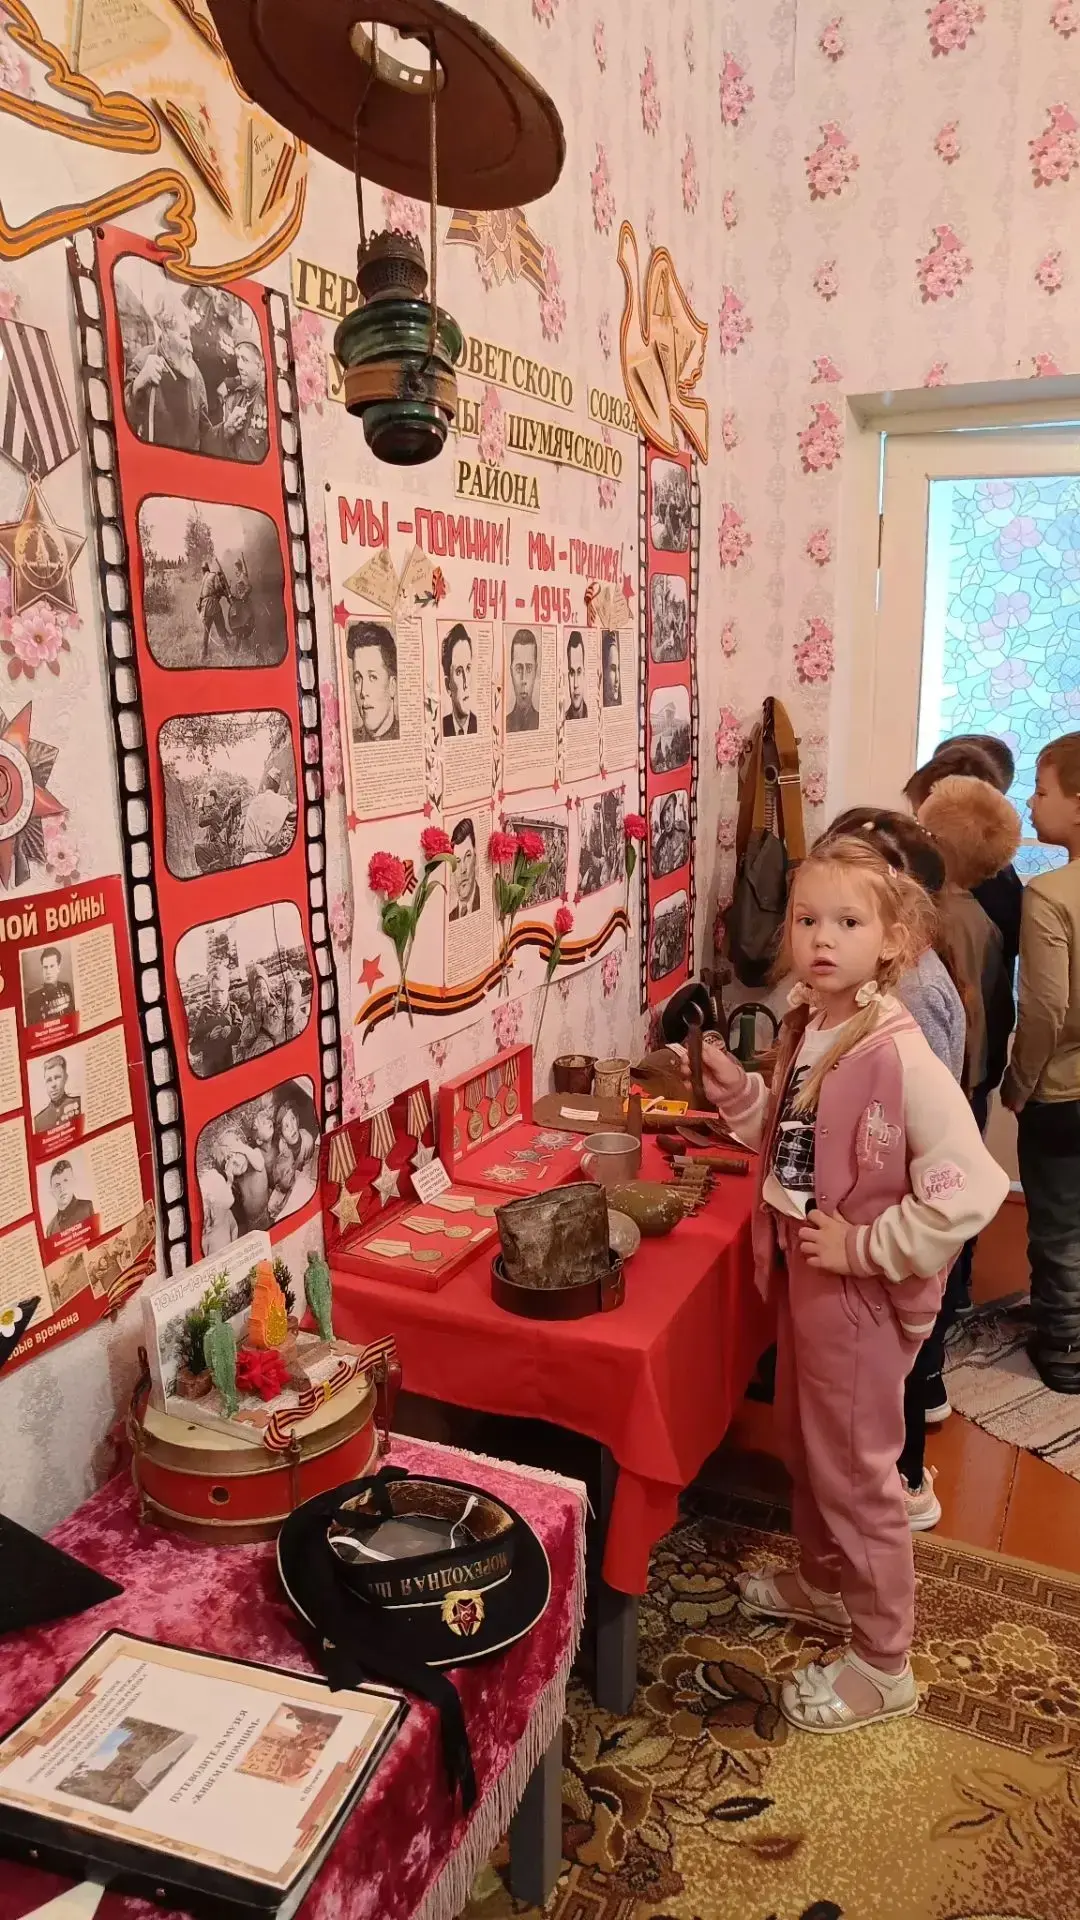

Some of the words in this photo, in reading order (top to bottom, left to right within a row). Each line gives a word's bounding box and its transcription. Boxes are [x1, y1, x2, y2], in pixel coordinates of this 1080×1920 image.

[297, 258, 364, 317] ГЕР
[590, 388, 638, 433] СОЮЗА
[507, 415, 622, 477] ШУМЯЧСКОГО
[457, 459, 540, 509] РАЙОНА
[45, 892, 105, 932] ВОЙНЫ
[34, 1312, 80, 1344] времена
[400, 1551, 508, 1596] МОРЕХОДНАЯ
[168, 1738, 227, 1803] ПУТЕВОДИТЕЛЬ
[220, 1709, 249, 1738] МУЗЕЯ
